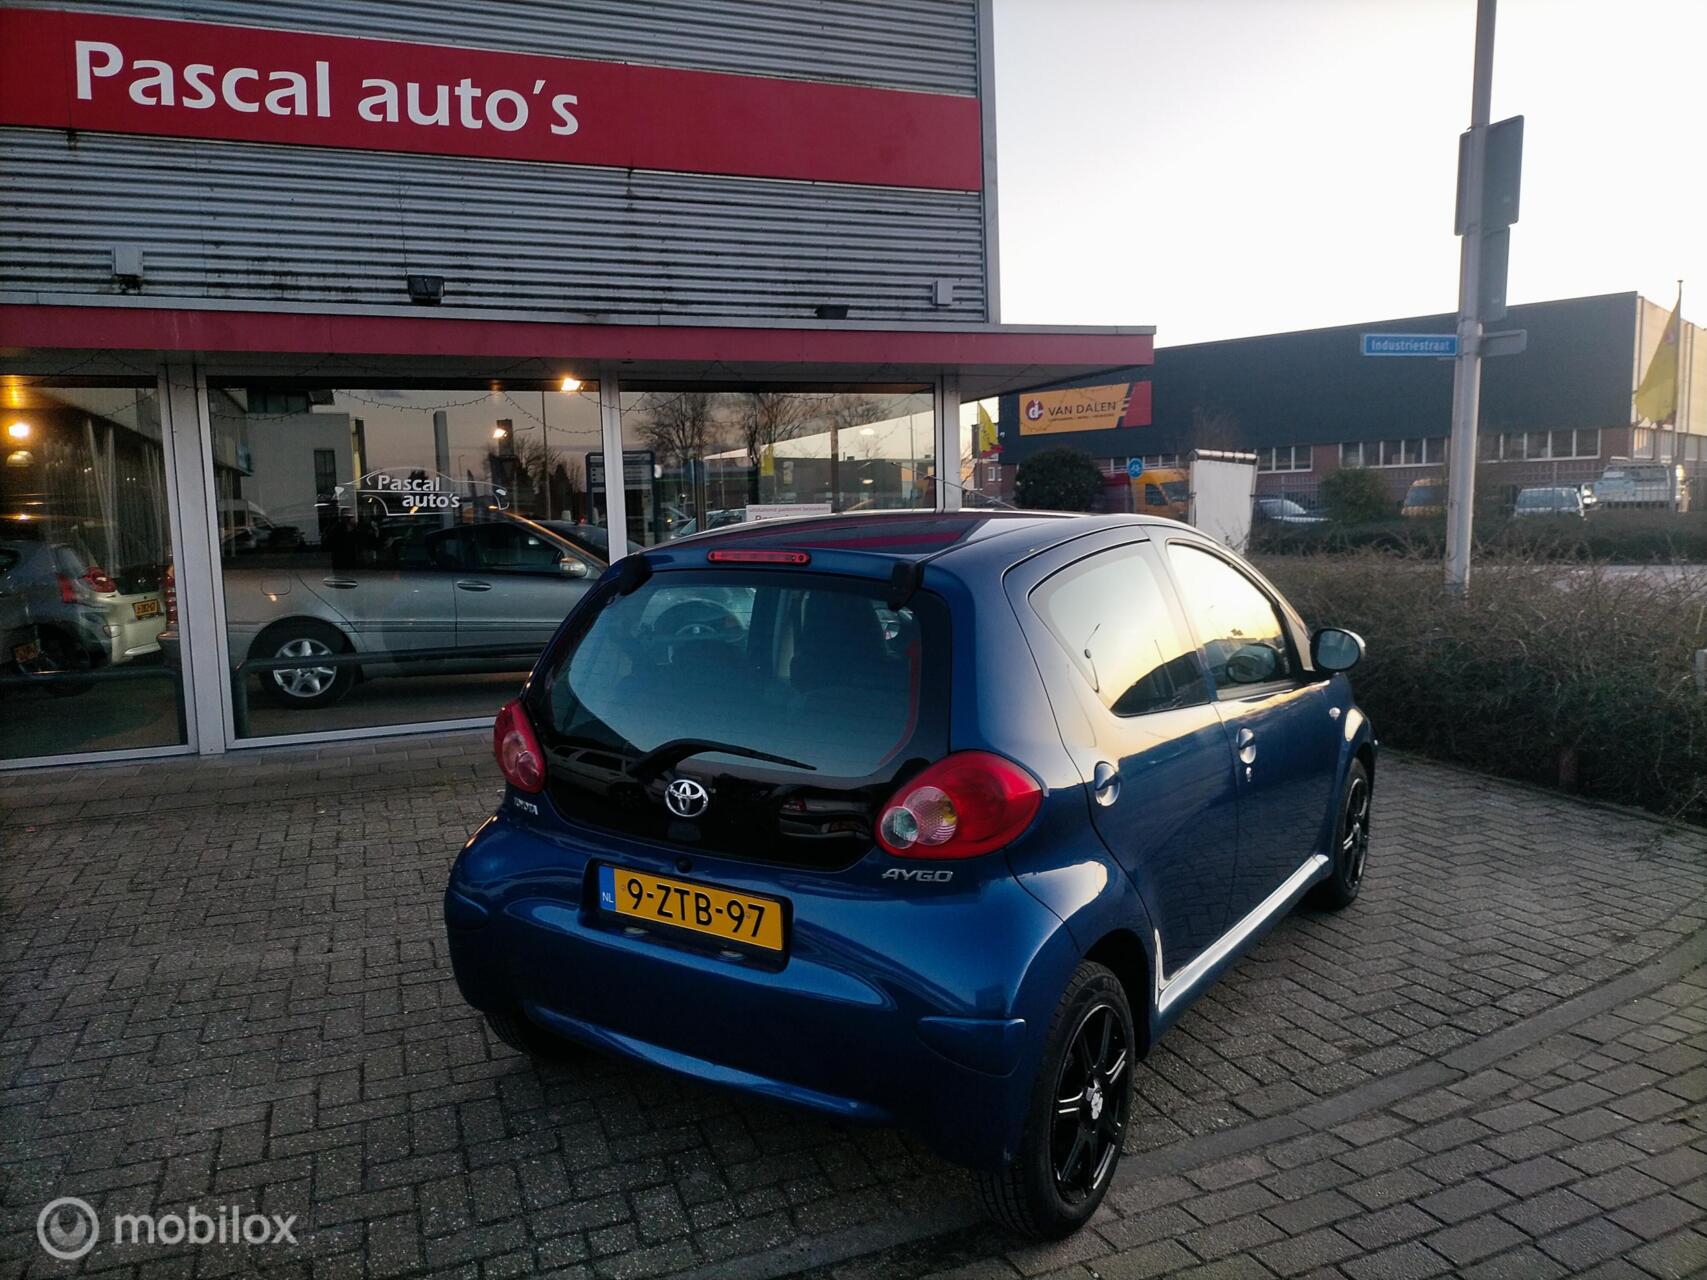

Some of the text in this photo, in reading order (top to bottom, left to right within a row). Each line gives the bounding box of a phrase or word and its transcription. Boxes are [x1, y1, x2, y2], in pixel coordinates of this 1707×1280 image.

[75, 39, 579, 136] Pascal auto's
[1371, 338, 1450, 351] Industriestraat
[1048, 401, 1117, 417] VAN DALEN
[377, 474, 440, 491] Pascal
[402, 493, 460, 508] auto's
[882, 868, 954, 882] AYGO
[602, 891, 614, 904] NL
[627, 878, 766, 938] 9-ZTB-97
